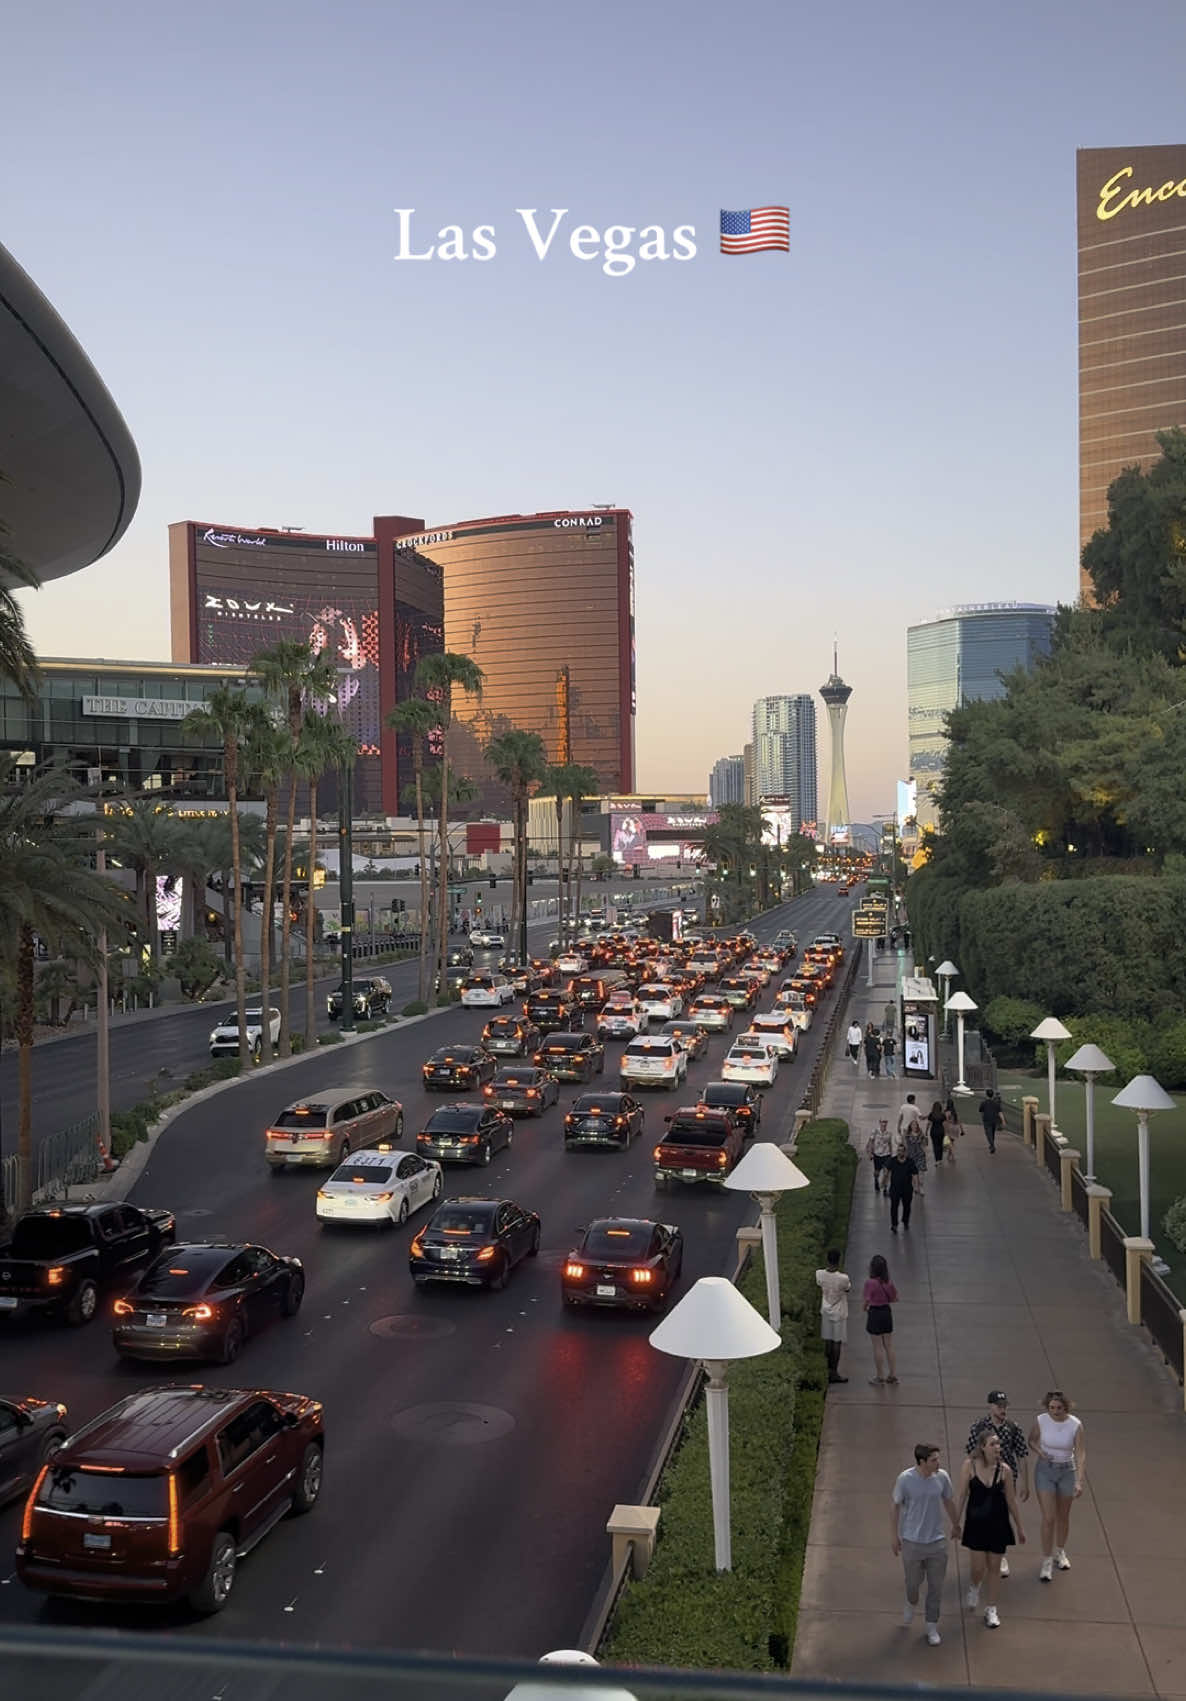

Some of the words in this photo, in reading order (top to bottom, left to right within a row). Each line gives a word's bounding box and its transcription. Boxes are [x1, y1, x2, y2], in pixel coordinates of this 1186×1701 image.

[554, 517, 602, 528] CONRAD
[326, 540, 364, 552] Hilton
[396, 531, 453, 549] CROCKFORDS
[87, 698, 127, 714] THE
